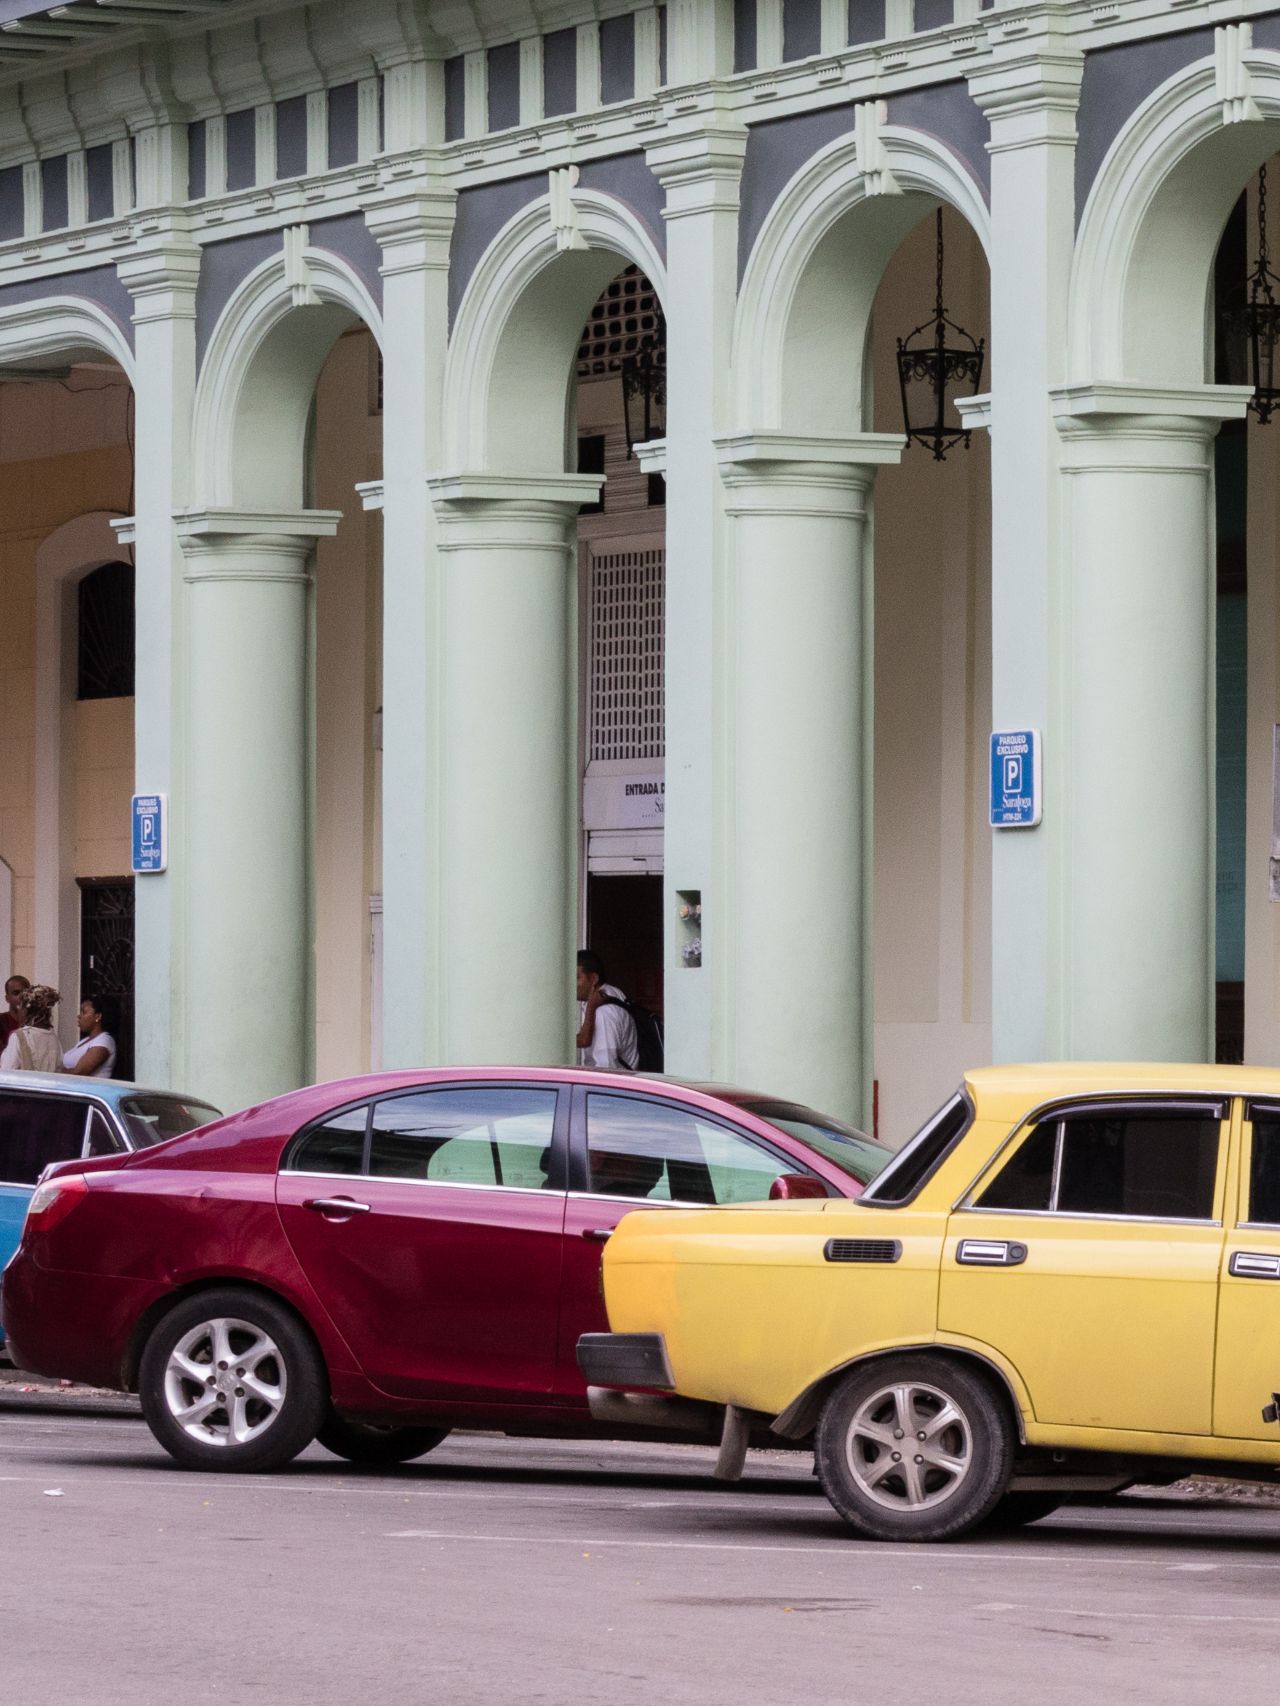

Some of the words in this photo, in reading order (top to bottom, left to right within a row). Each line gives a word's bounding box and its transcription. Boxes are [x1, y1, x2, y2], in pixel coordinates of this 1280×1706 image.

[999, 735, 1026, 745] PARQUEO
[996, 744, 1029, 755] EXCLUSIVO
[1007, 760, 1019, 787] P
[625, 782, 659, 796] ENTRADA
[144, 818, 152, 841] P
